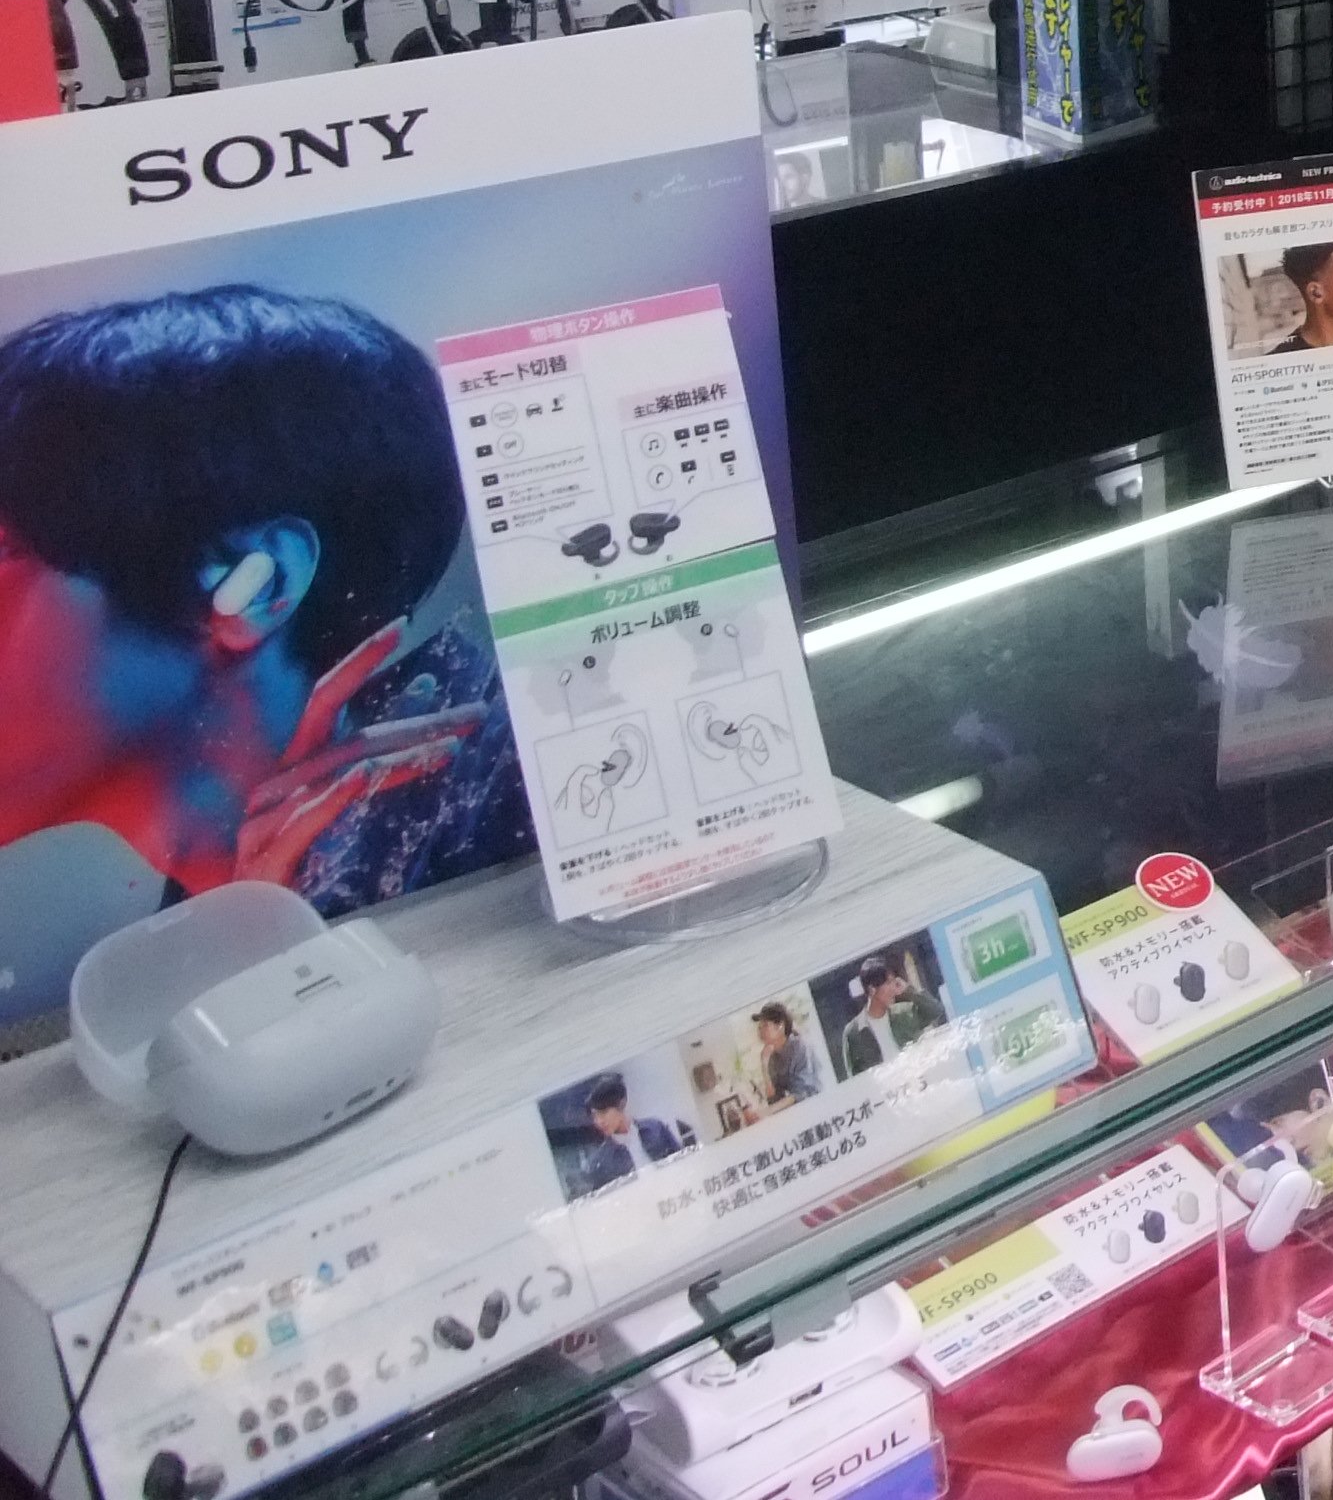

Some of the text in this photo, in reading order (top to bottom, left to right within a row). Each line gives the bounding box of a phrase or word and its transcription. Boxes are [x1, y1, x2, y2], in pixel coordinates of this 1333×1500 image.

[124, 107, 429, 206] SONY
[1302, 168, 1322, 178] NEW
[1211, 196, 1266, 214] 予約受付中
[458, 354, 568, 394] 主にモード切替
[1231, 363, 1315, 384] ATH-SPORT7TW
[633, 383, 728, 420] 主に楽曲操作
[590, 600, 702, 644] ボリューム調整
[1145, 862, 1200, 899] NEW
[1099, 914, 1205, 968] 防水&メモリー搭載
[1106, 923, 1217, 980] アクティブワイヤレス
[1062, 1160, 1174, 1226] 防水&メモリー搭載
[1074, 1172, 1189, 1239] アクティブワイヤレス
[811, 1427, 911, 1495] SOUL
